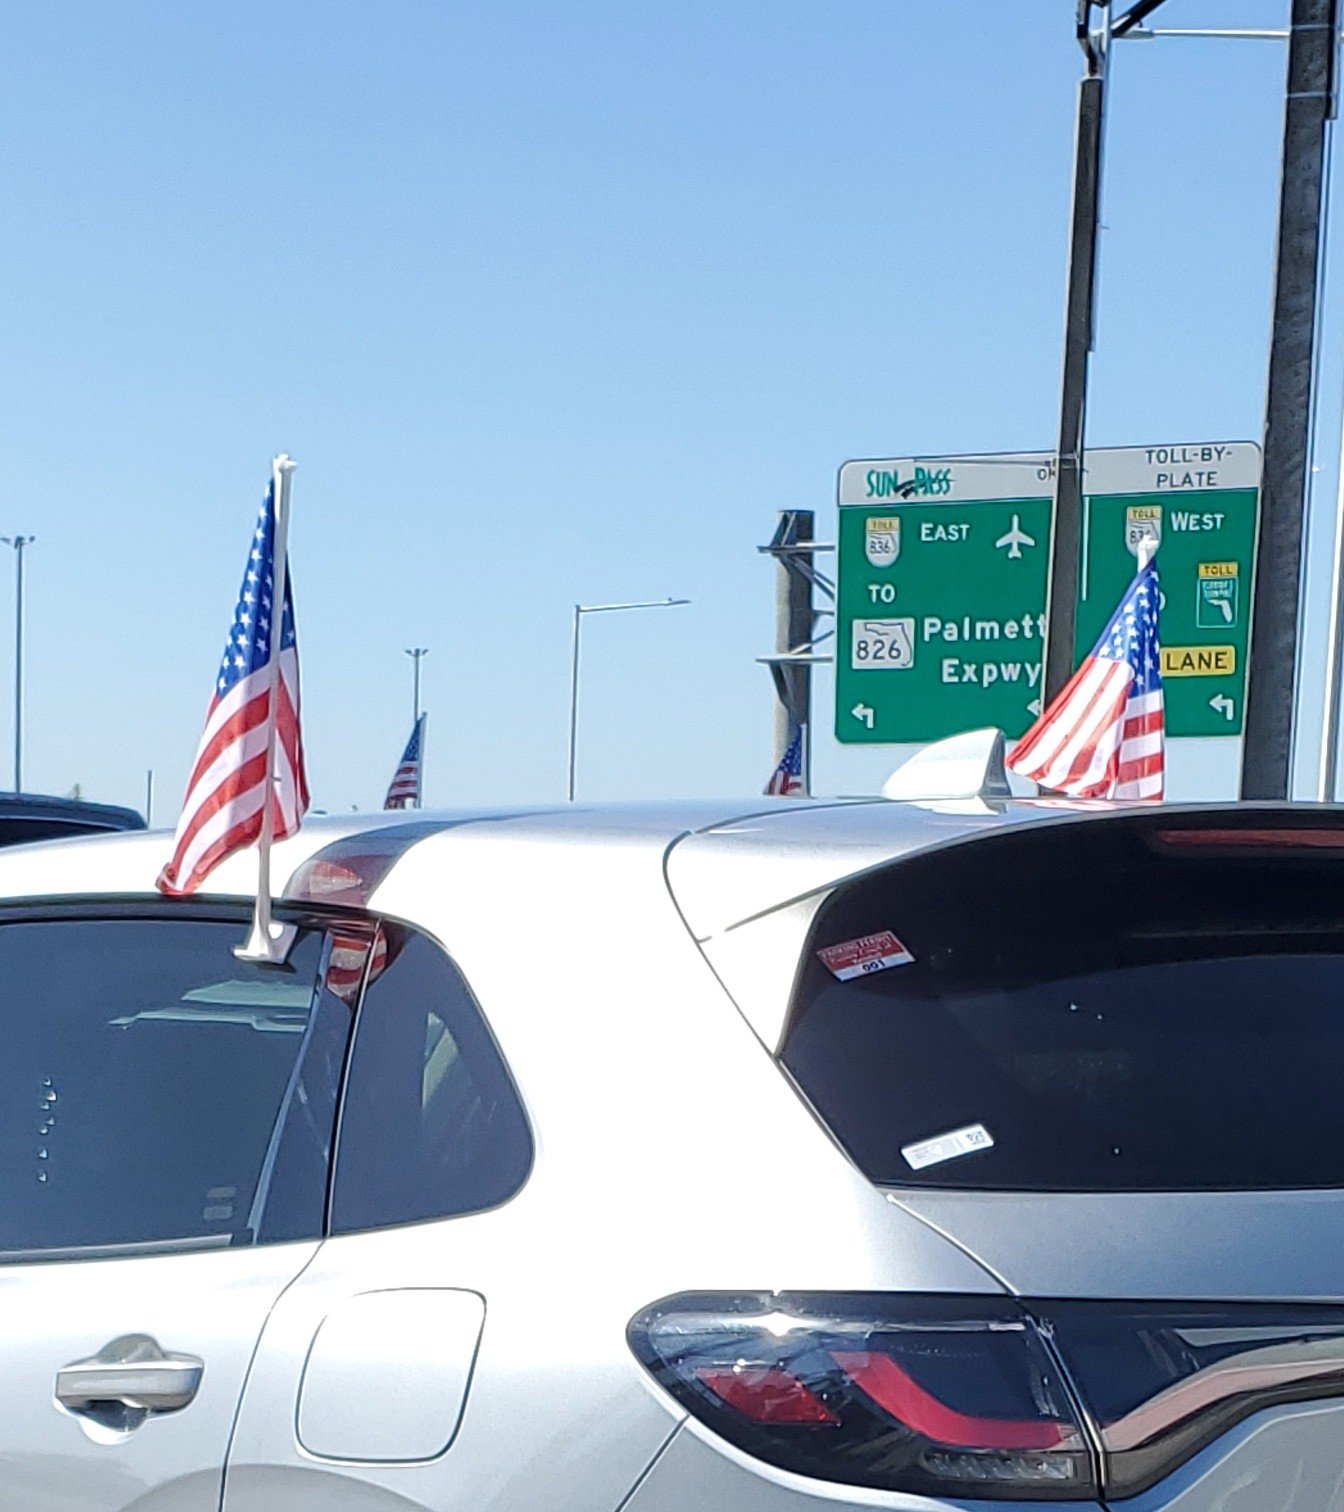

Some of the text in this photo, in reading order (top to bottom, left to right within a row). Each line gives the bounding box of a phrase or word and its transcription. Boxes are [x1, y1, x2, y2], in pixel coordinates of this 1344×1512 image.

[1145, 446, 1232, 464] TOLL-BY-
[1156, 470, 1218, 488] PLATE
[1170, 511, 1225, 532] WEST
[920, 522, 971, 542] EAST
[1203, 564, 1234, 576] TOLL
[867, 583, 896, 603] TO
[856, 639, 902, 661] 826
[1166, 651, 1228, 671] LANE
[941, 657, 1042, 689] Expwy
